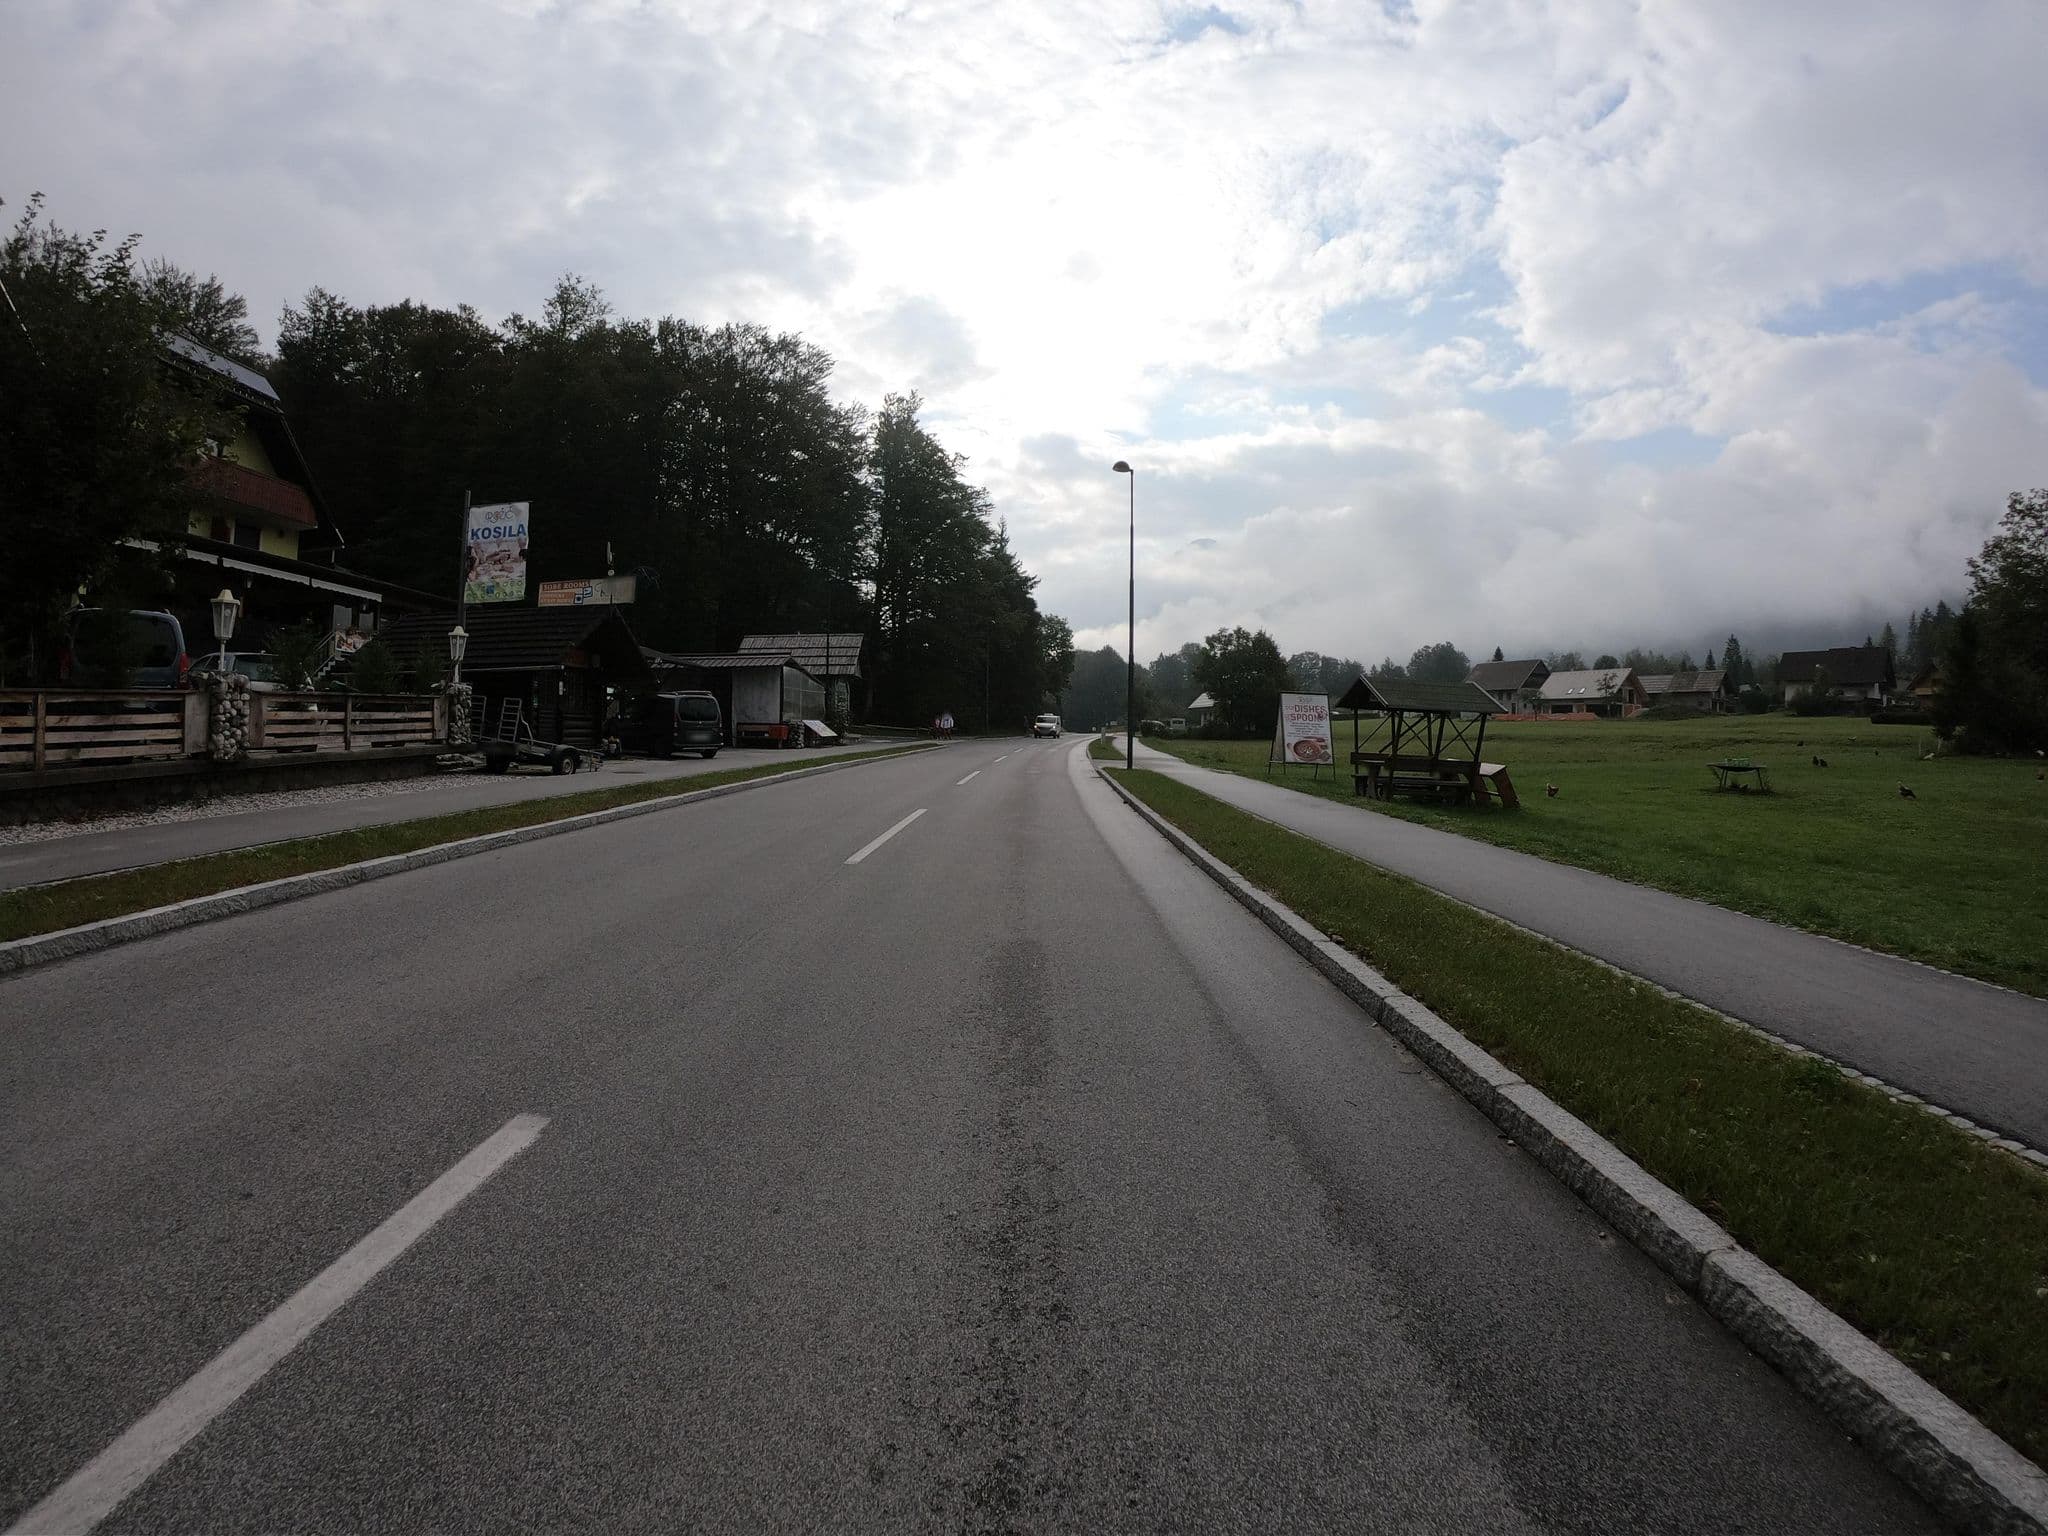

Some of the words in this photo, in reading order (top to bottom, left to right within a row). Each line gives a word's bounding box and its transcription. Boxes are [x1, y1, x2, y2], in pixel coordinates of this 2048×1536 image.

[471, 523, 526, 541] KOSILA
[565, 581, 589, 589] ROOMS
[1294, 705, 1327, 714] DISHES
